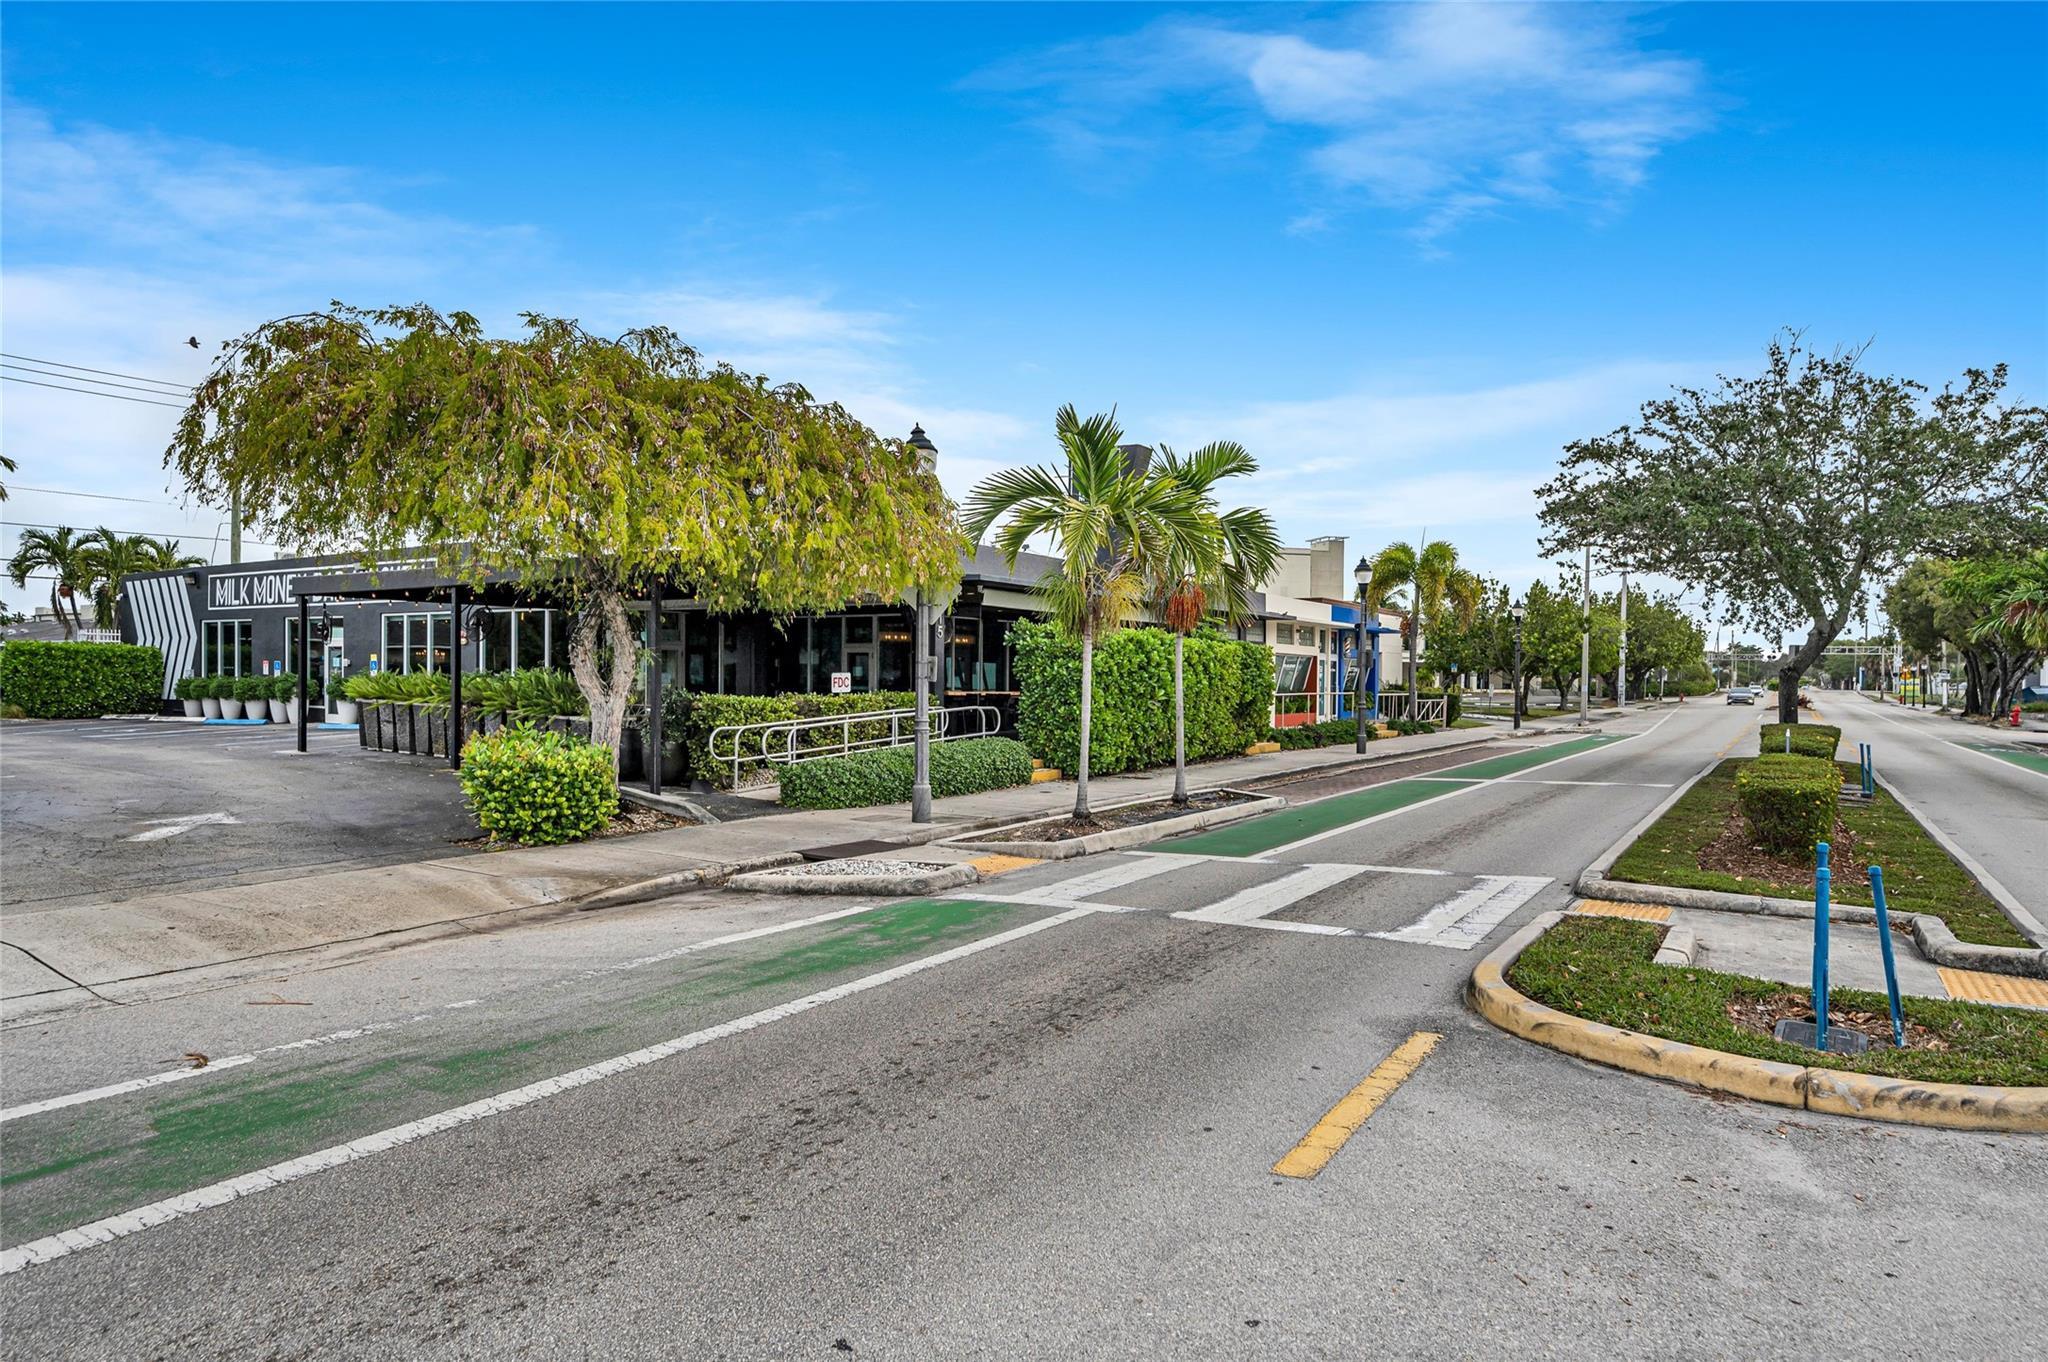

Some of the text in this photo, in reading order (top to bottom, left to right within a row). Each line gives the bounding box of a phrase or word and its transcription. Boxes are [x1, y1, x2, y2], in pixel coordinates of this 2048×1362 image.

[216, 577, 250, 606] MILK
[253, 572, 307, 604] MONE
[833, 676, 850, 688] FDC
